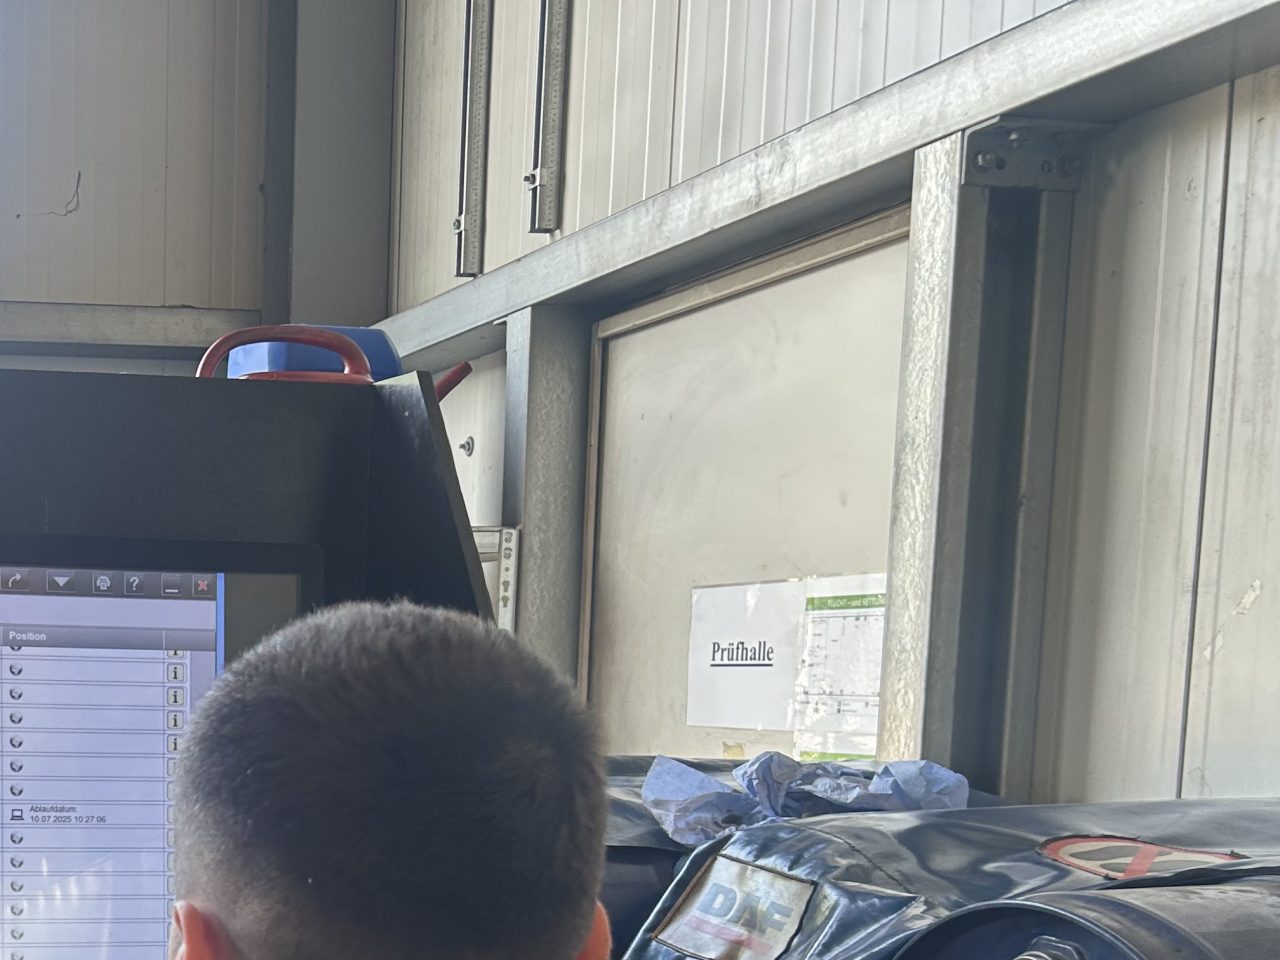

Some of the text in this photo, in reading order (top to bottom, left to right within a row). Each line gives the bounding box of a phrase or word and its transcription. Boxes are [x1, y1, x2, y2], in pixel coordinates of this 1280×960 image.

[8, 631, 46, 642] Position
[711, 640, 774, 662] Prüfhalle
[695, 881, 796, 935] DAF
